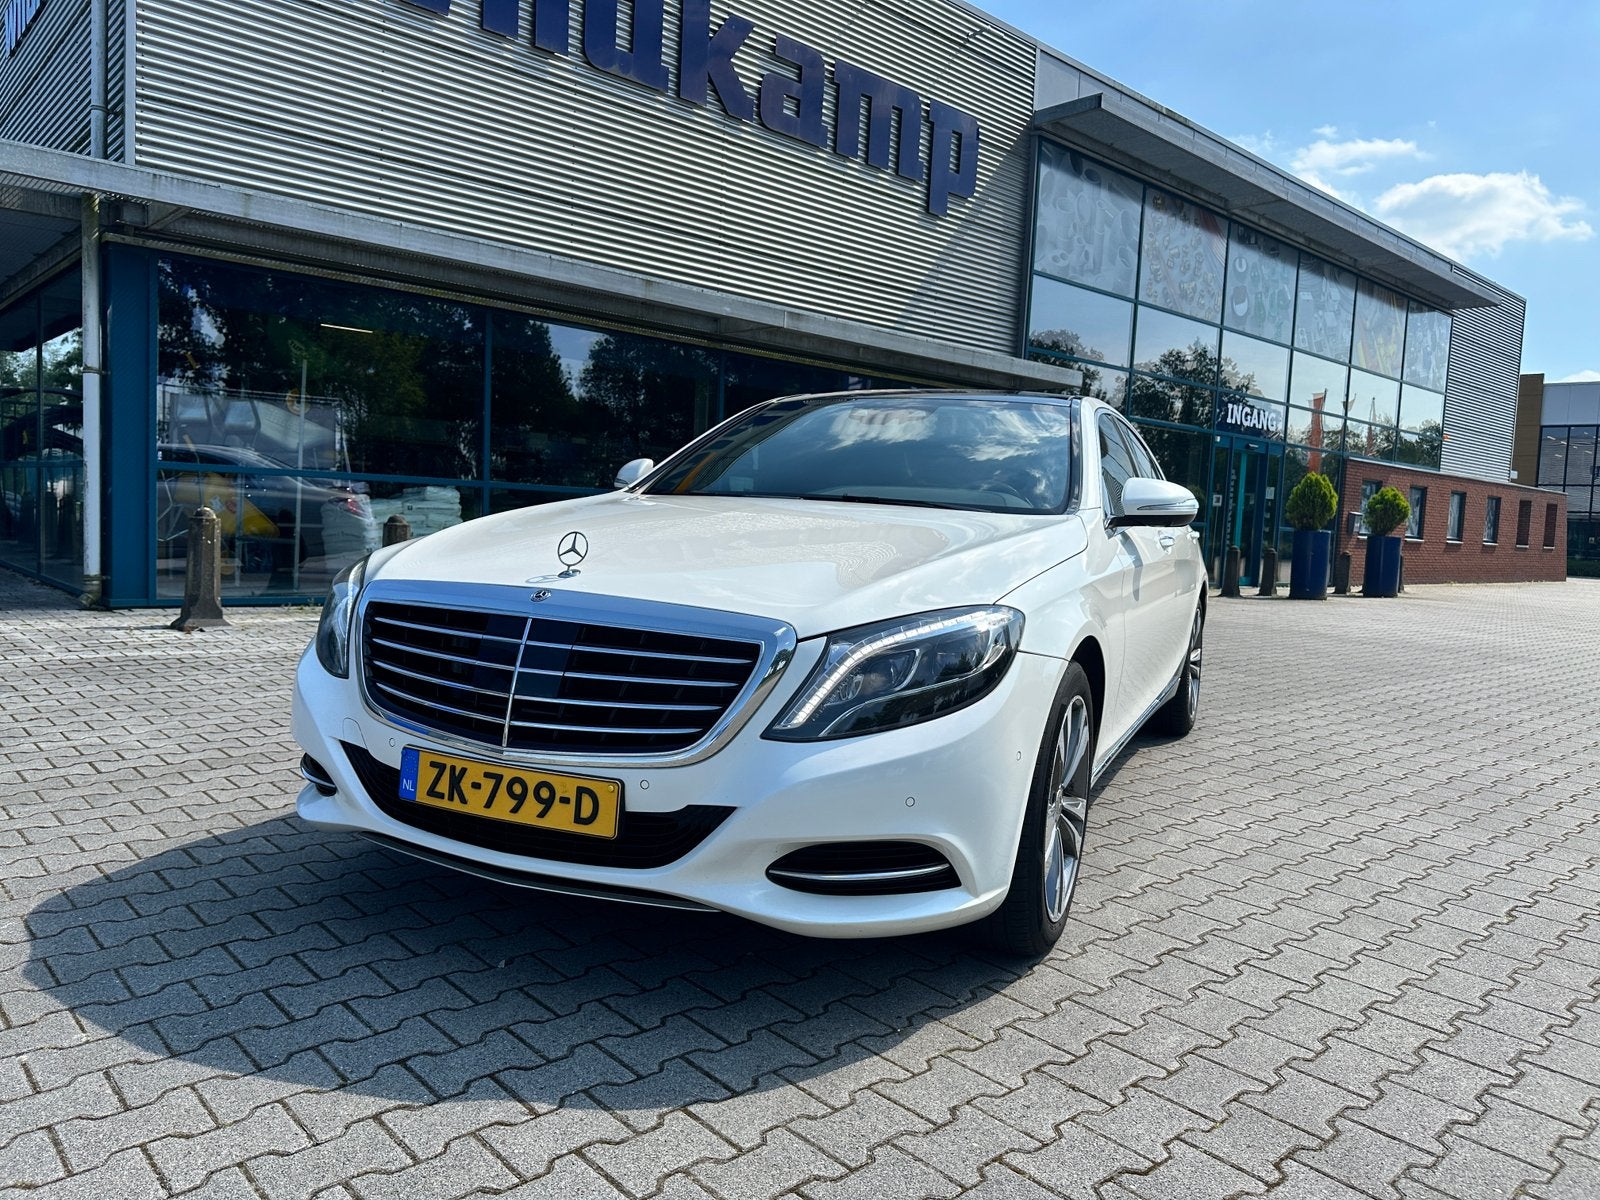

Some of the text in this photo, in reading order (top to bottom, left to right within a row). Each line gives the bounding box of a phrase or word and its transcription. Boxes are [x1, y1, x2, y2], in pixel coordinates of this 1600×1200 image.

[1226, 403, 1277, 432] INGANG
[402, 778, 415, 792] NL
[426, 760, 600, 826] ZK-799-D
